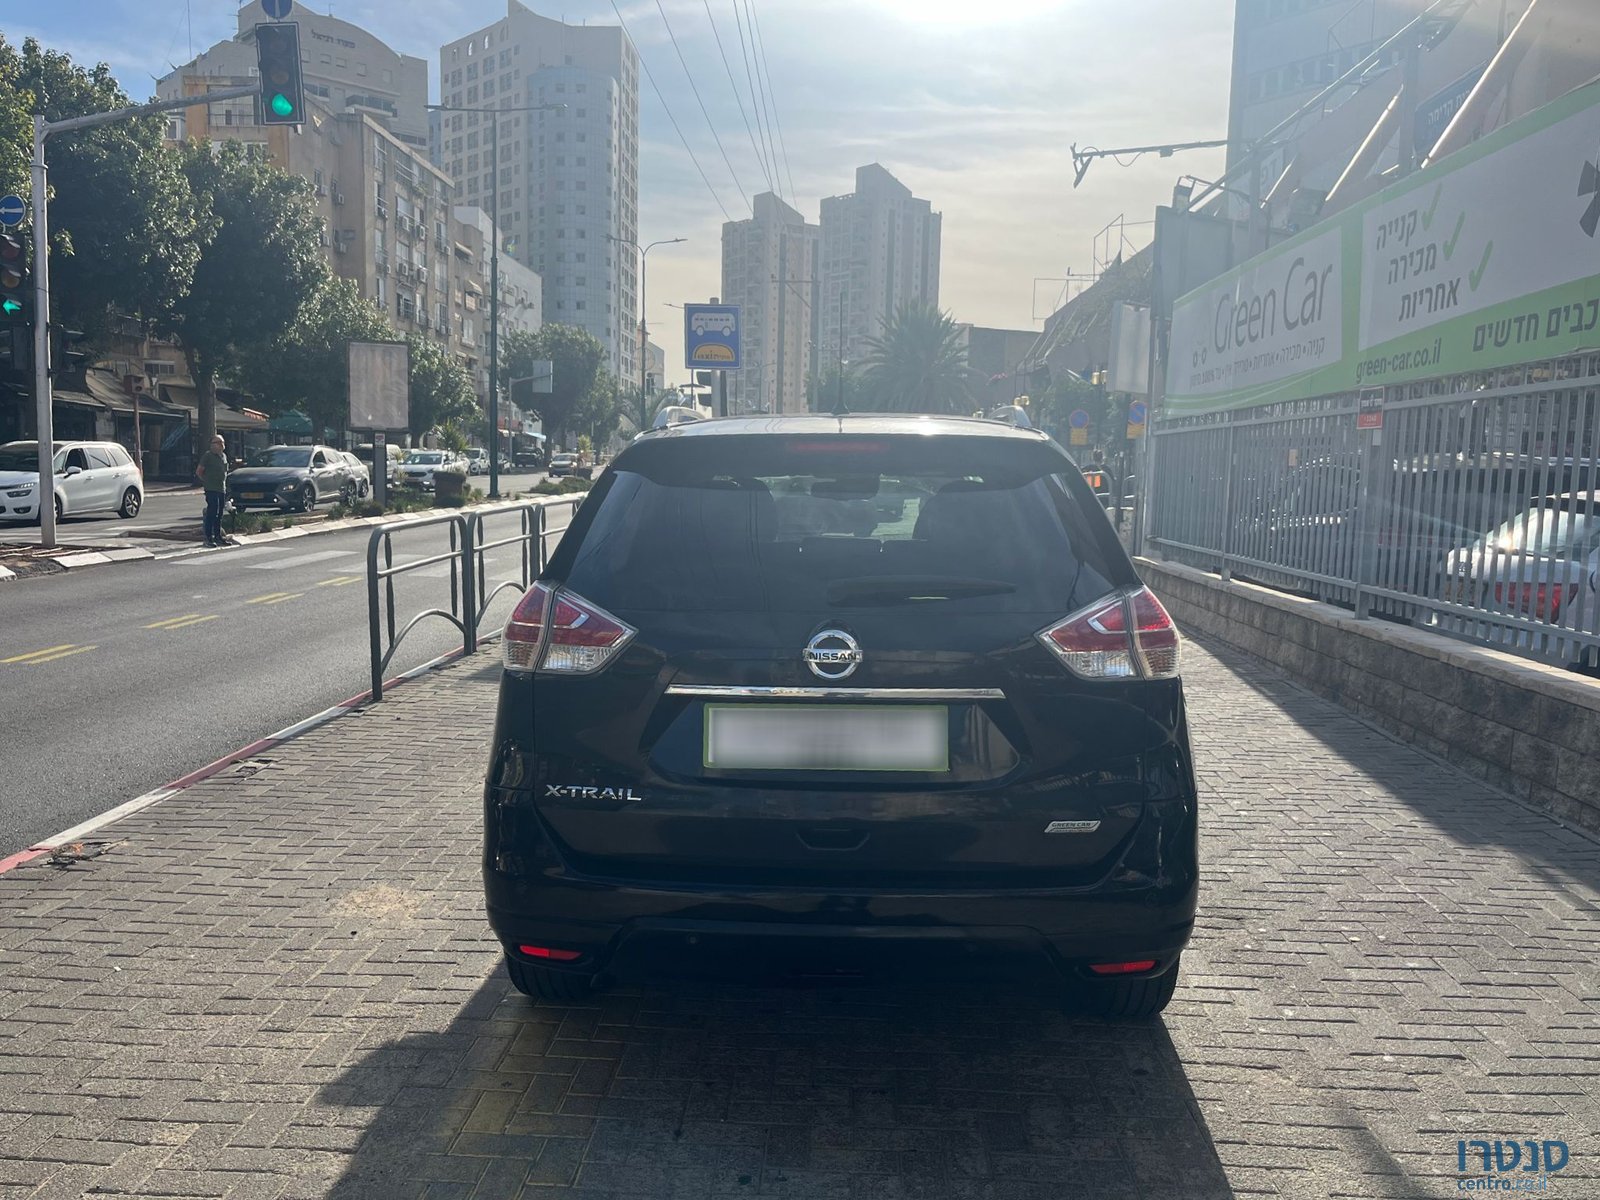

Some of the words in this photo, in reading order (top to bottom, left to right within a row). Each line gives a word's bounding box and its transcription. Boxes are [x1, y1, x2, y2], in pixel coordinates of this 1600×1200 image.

[1376, 209, 1418, 251] קנייה
[1387, 242, 1438, 285] מכירה
[1214, 288, 1276, 354] Green
[1283, 257, 1333, 331] Car
[1398, 277, 1461, 322] אחריות
[1472, 312, 1540, 352] חדשים
[1355, 337, 1442, 384] green-car.co.il
[808, 652, 857, 661] NISSAN
[544, 784, 643, 802] X-TRAIL
